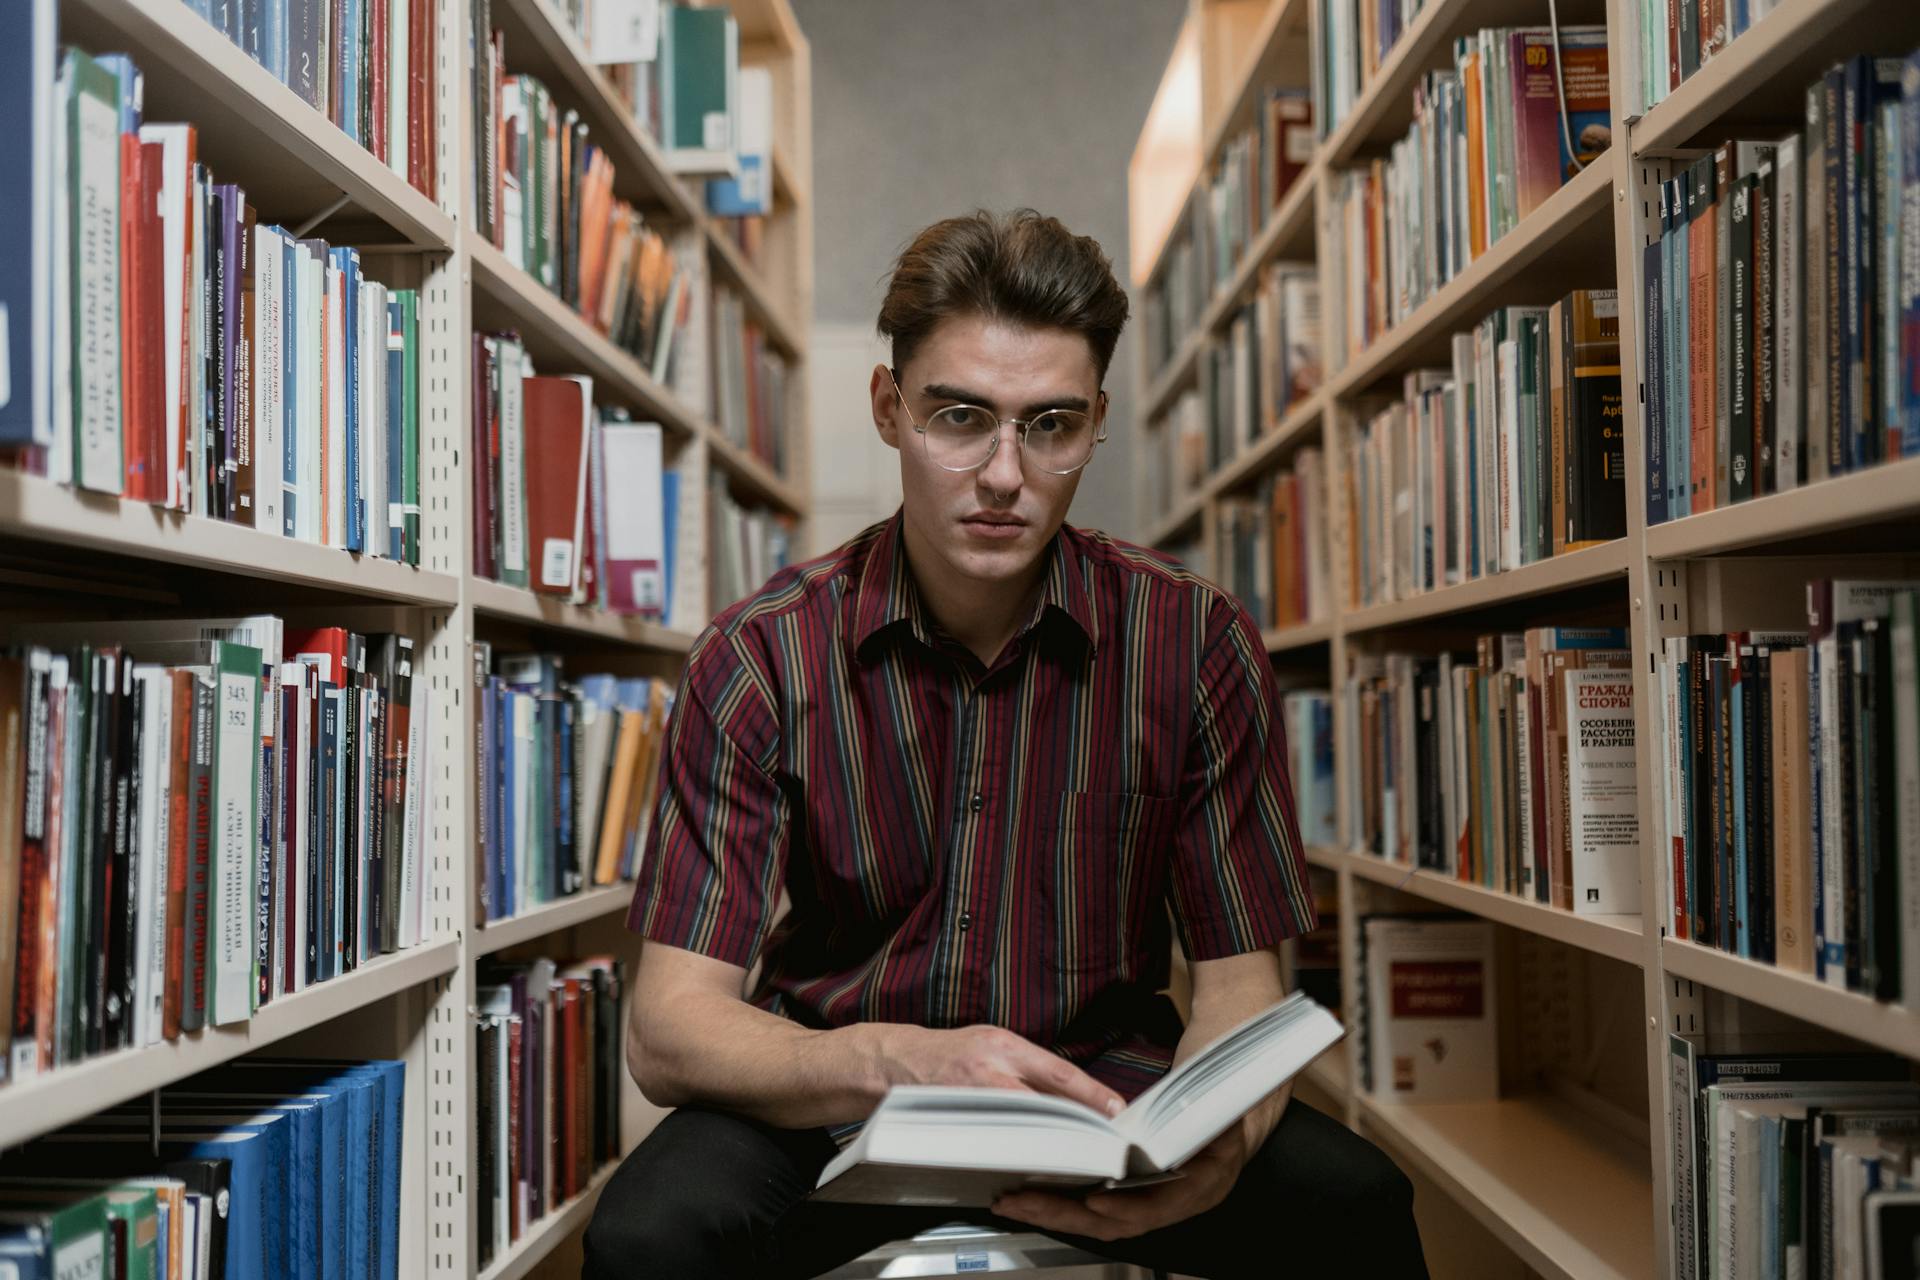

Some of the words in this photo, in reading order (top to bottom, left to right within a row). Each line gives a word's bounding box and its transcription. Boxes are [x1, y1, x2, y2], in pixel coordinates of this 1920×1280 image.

[217, 249, 225, 313] ЭРОТИКА
[1734, 259, 1744, 308] надзор
[1761, 196, 1771, 327] ПРОКУРОРСКИЙ
[1783, 194, 1791, 319] ПРОКУРОРСКИЙ
[217, 327, 225, 432] ПОРНОГРАФИЯ
[1734, 313, 1745, 415] Прокурорский
[1762, 335, 1772, 403] НАДЗОР
[227, 711, 247, 728] 352
[1579, 697, 1630, 709] СПОРЫ
[1697, 691, 1705, 754] Адвокатура
[1581, 738, 1589, 748] И
[1722, 698, 1732, 847] АДВОКАТУРА
[1562, 753, 1571, 852] ГРАЖДАНСКИЙ
[406, 792, 414, 892] ПРОТИВОДЕЙСТВИЕ
[259, 902, 269, 966] ДАВАЙ
